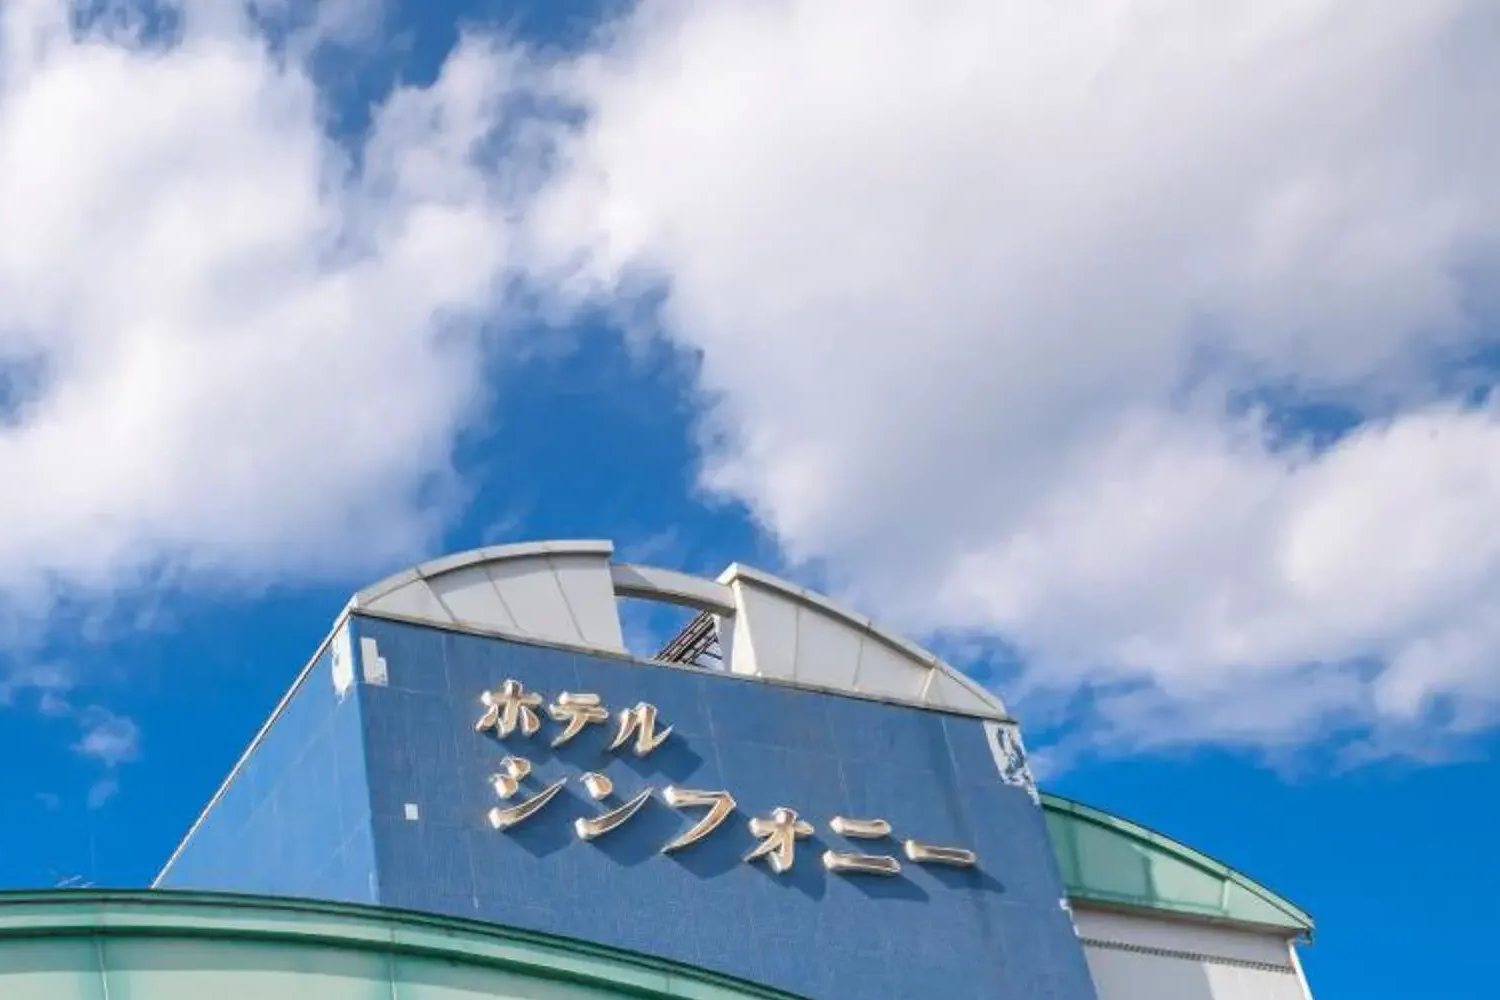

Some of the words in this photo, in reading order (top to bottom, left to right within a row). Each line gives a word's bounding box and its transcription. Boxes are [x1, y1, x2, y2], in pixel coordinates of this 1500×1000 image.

[474, 678, 674, 756] ホテル
[487, 756, 979, 875] シンフォニー
